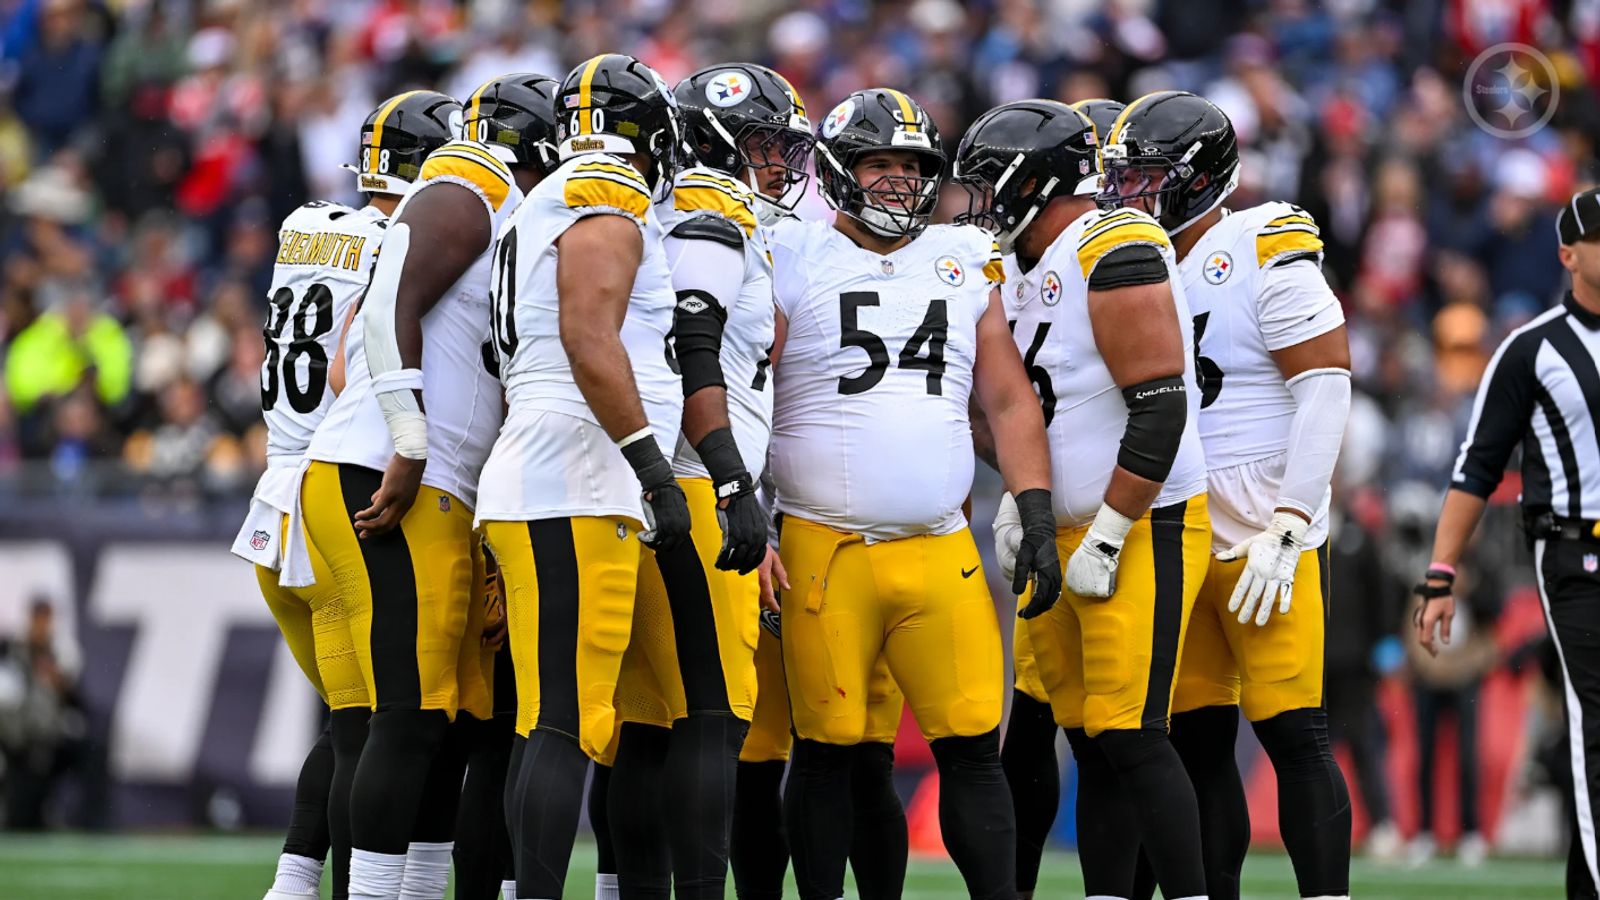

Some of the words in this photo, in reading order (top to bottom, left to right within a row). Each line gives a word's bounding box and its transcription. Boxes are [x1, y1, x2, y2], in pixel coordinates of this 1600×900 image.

[570, 108, 604, 136] 60
[570, 138, 605, 153] Steelers
[362, 148, 390, 174] 88
[837, 291, 949, 397] 54
